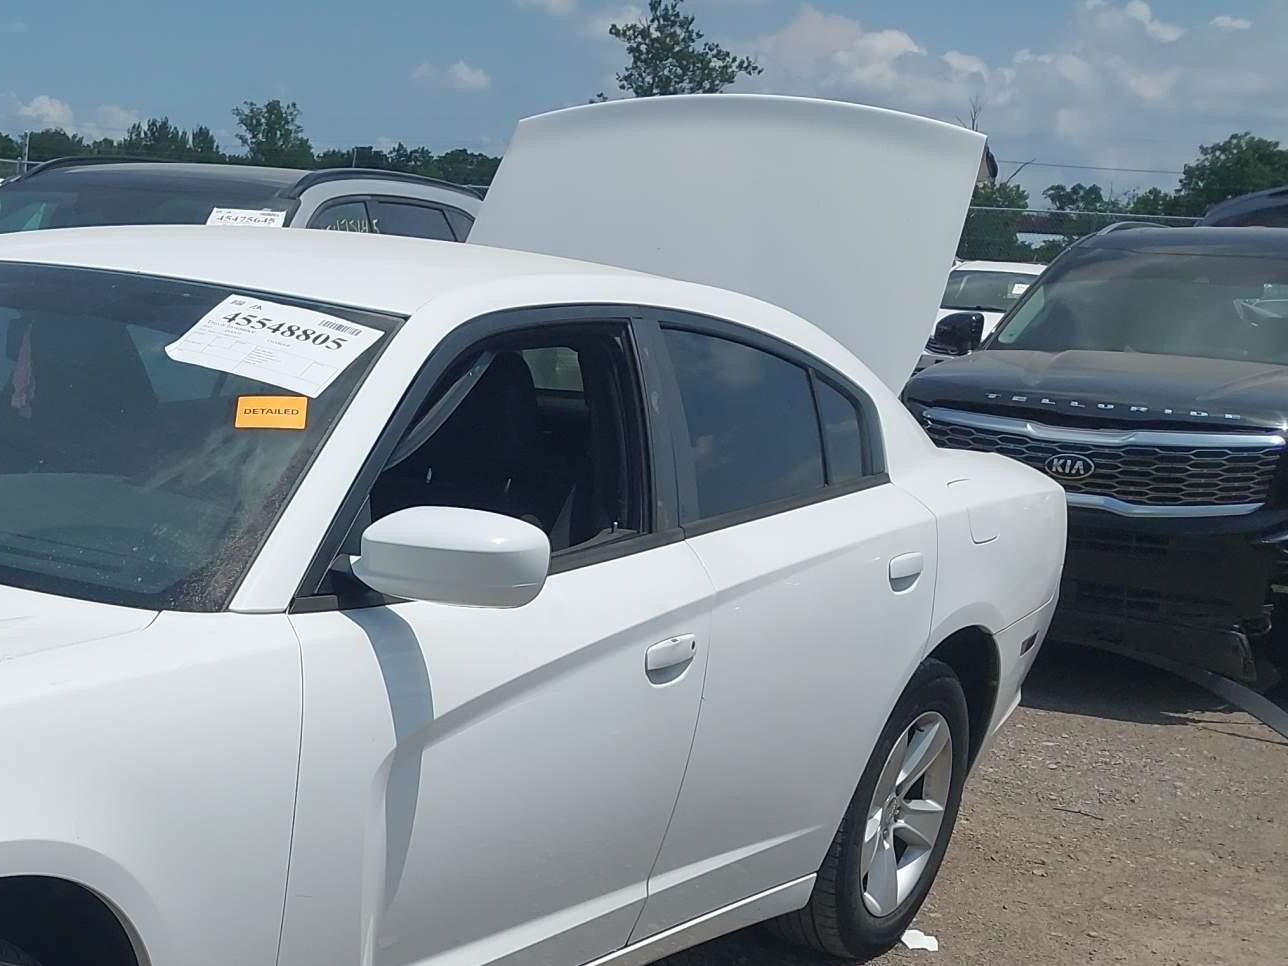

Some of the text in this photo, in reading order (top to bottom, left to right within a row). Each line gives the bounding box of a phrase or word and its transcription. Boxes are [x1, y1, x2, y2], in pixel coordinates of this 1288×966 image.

[223, 311, 349, 351] 45548805
[243, 407, 300, 416] DETAILED
[985, 392, 1242, 420] TELLURIDE
[1050, 458, 1086, 476] KIA
